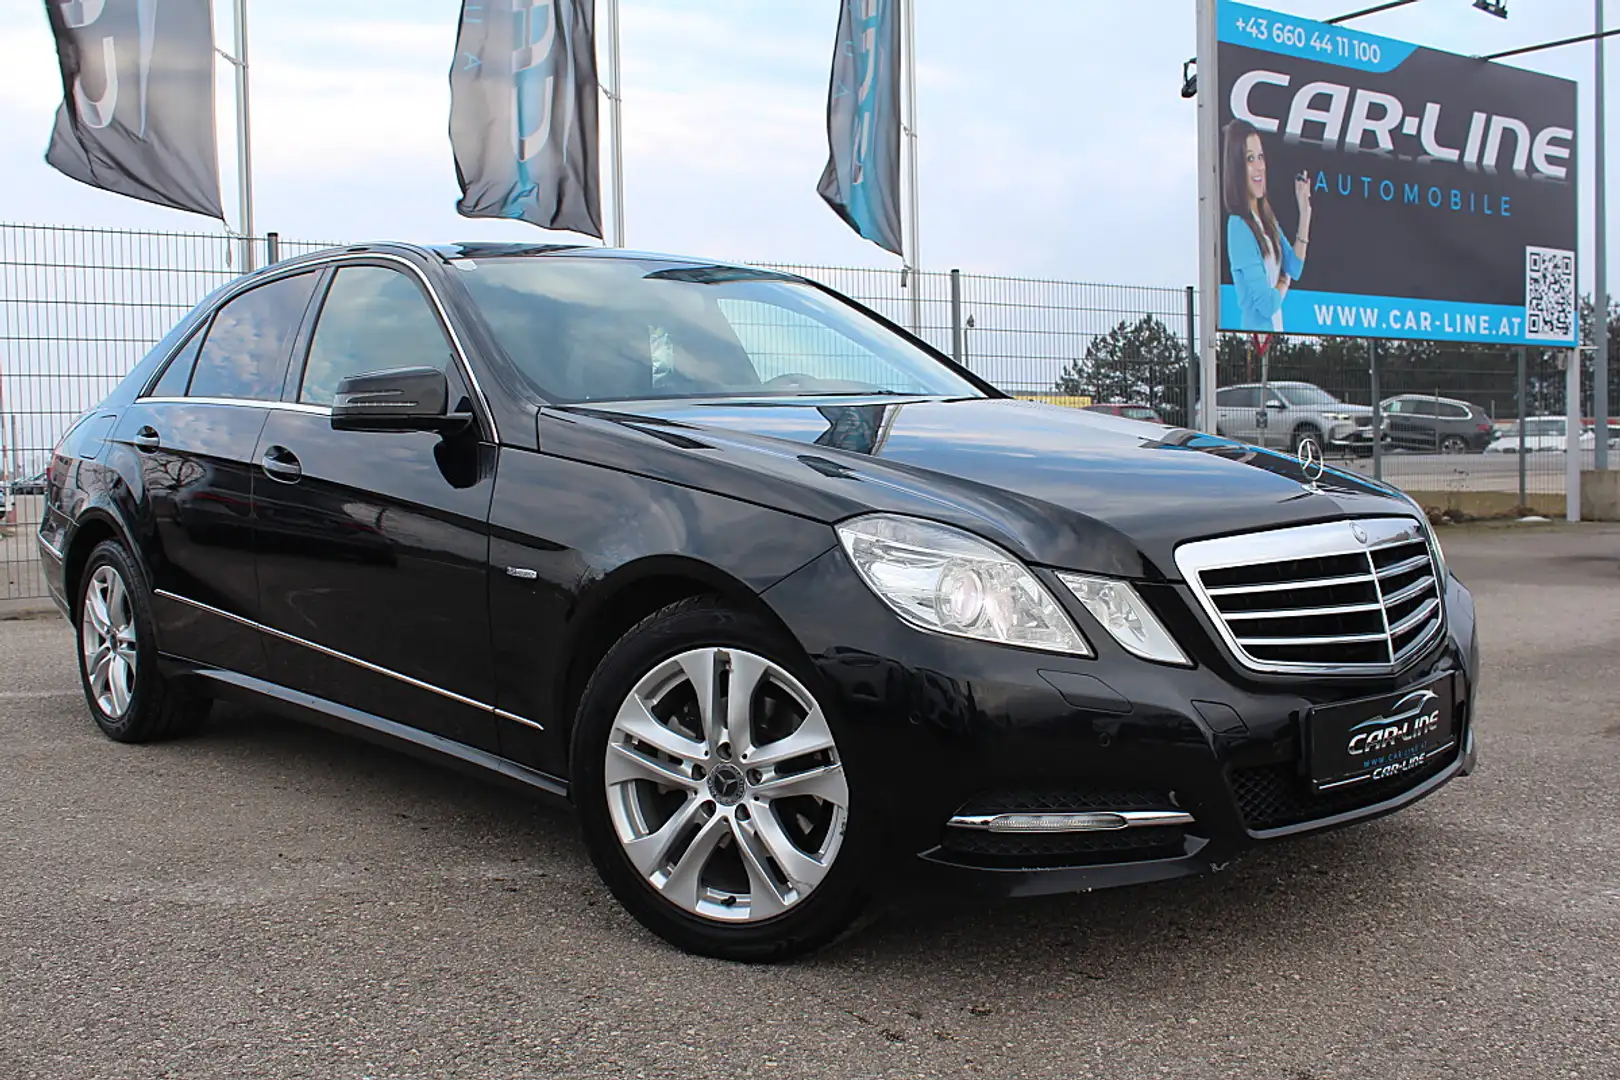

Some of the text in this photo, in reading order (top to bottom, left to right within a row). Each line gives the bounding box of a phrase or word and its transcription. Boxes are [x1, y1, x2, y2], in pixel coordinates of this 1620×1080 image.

[1235, 17, 1381, 63] +43 660 44 11 100
[1230, 69, 1574, 180] CAR-LINE
[1314, 170, 1512, 217] AUTOMOBILE
[1314, 303, 1523, 336] WWW.CAR-LINE.AT
[1347, 709, 1440, 755] CAR-LINE
[1372, 752, 1426, 780] CAR-LINE
